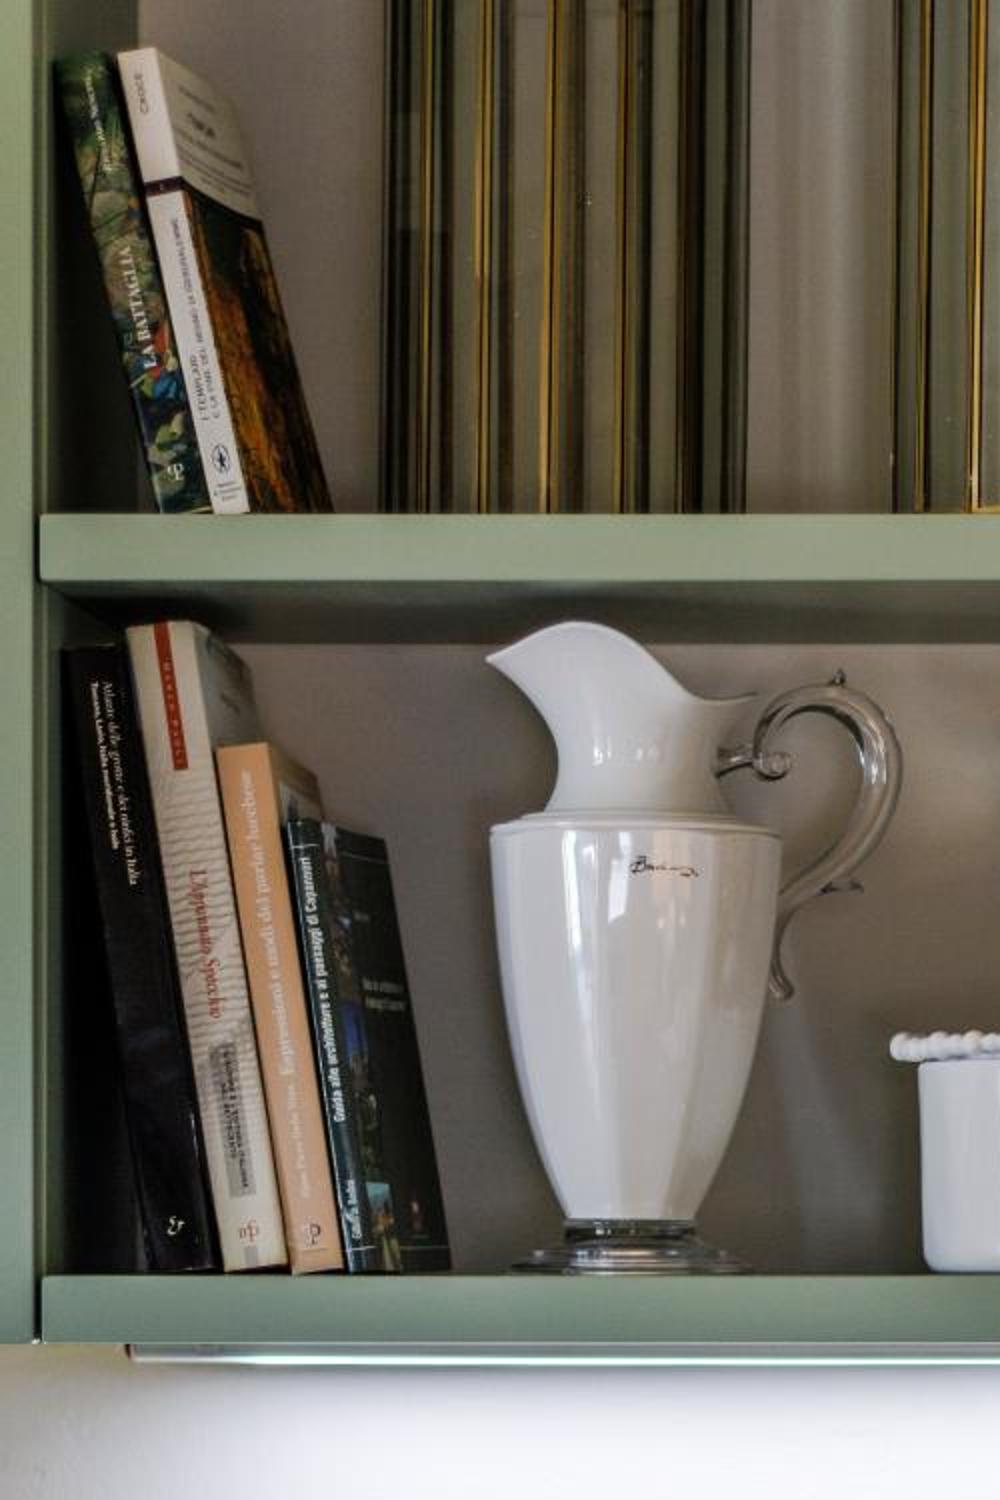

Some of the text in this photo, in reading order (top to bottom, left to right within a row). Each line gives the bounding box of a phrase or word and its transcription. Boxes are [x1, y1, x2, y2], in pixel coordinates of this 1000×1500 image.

[123, 247, 156, 368] LA BATTAGLIA
[102, 681, 116, 719] Atlante
[110, 750, 124, 784] grotte
[124, 845, 134, 857] in
[126, 858, 141, 886] Italia
[331, 1089, 346, 1122] Guida
